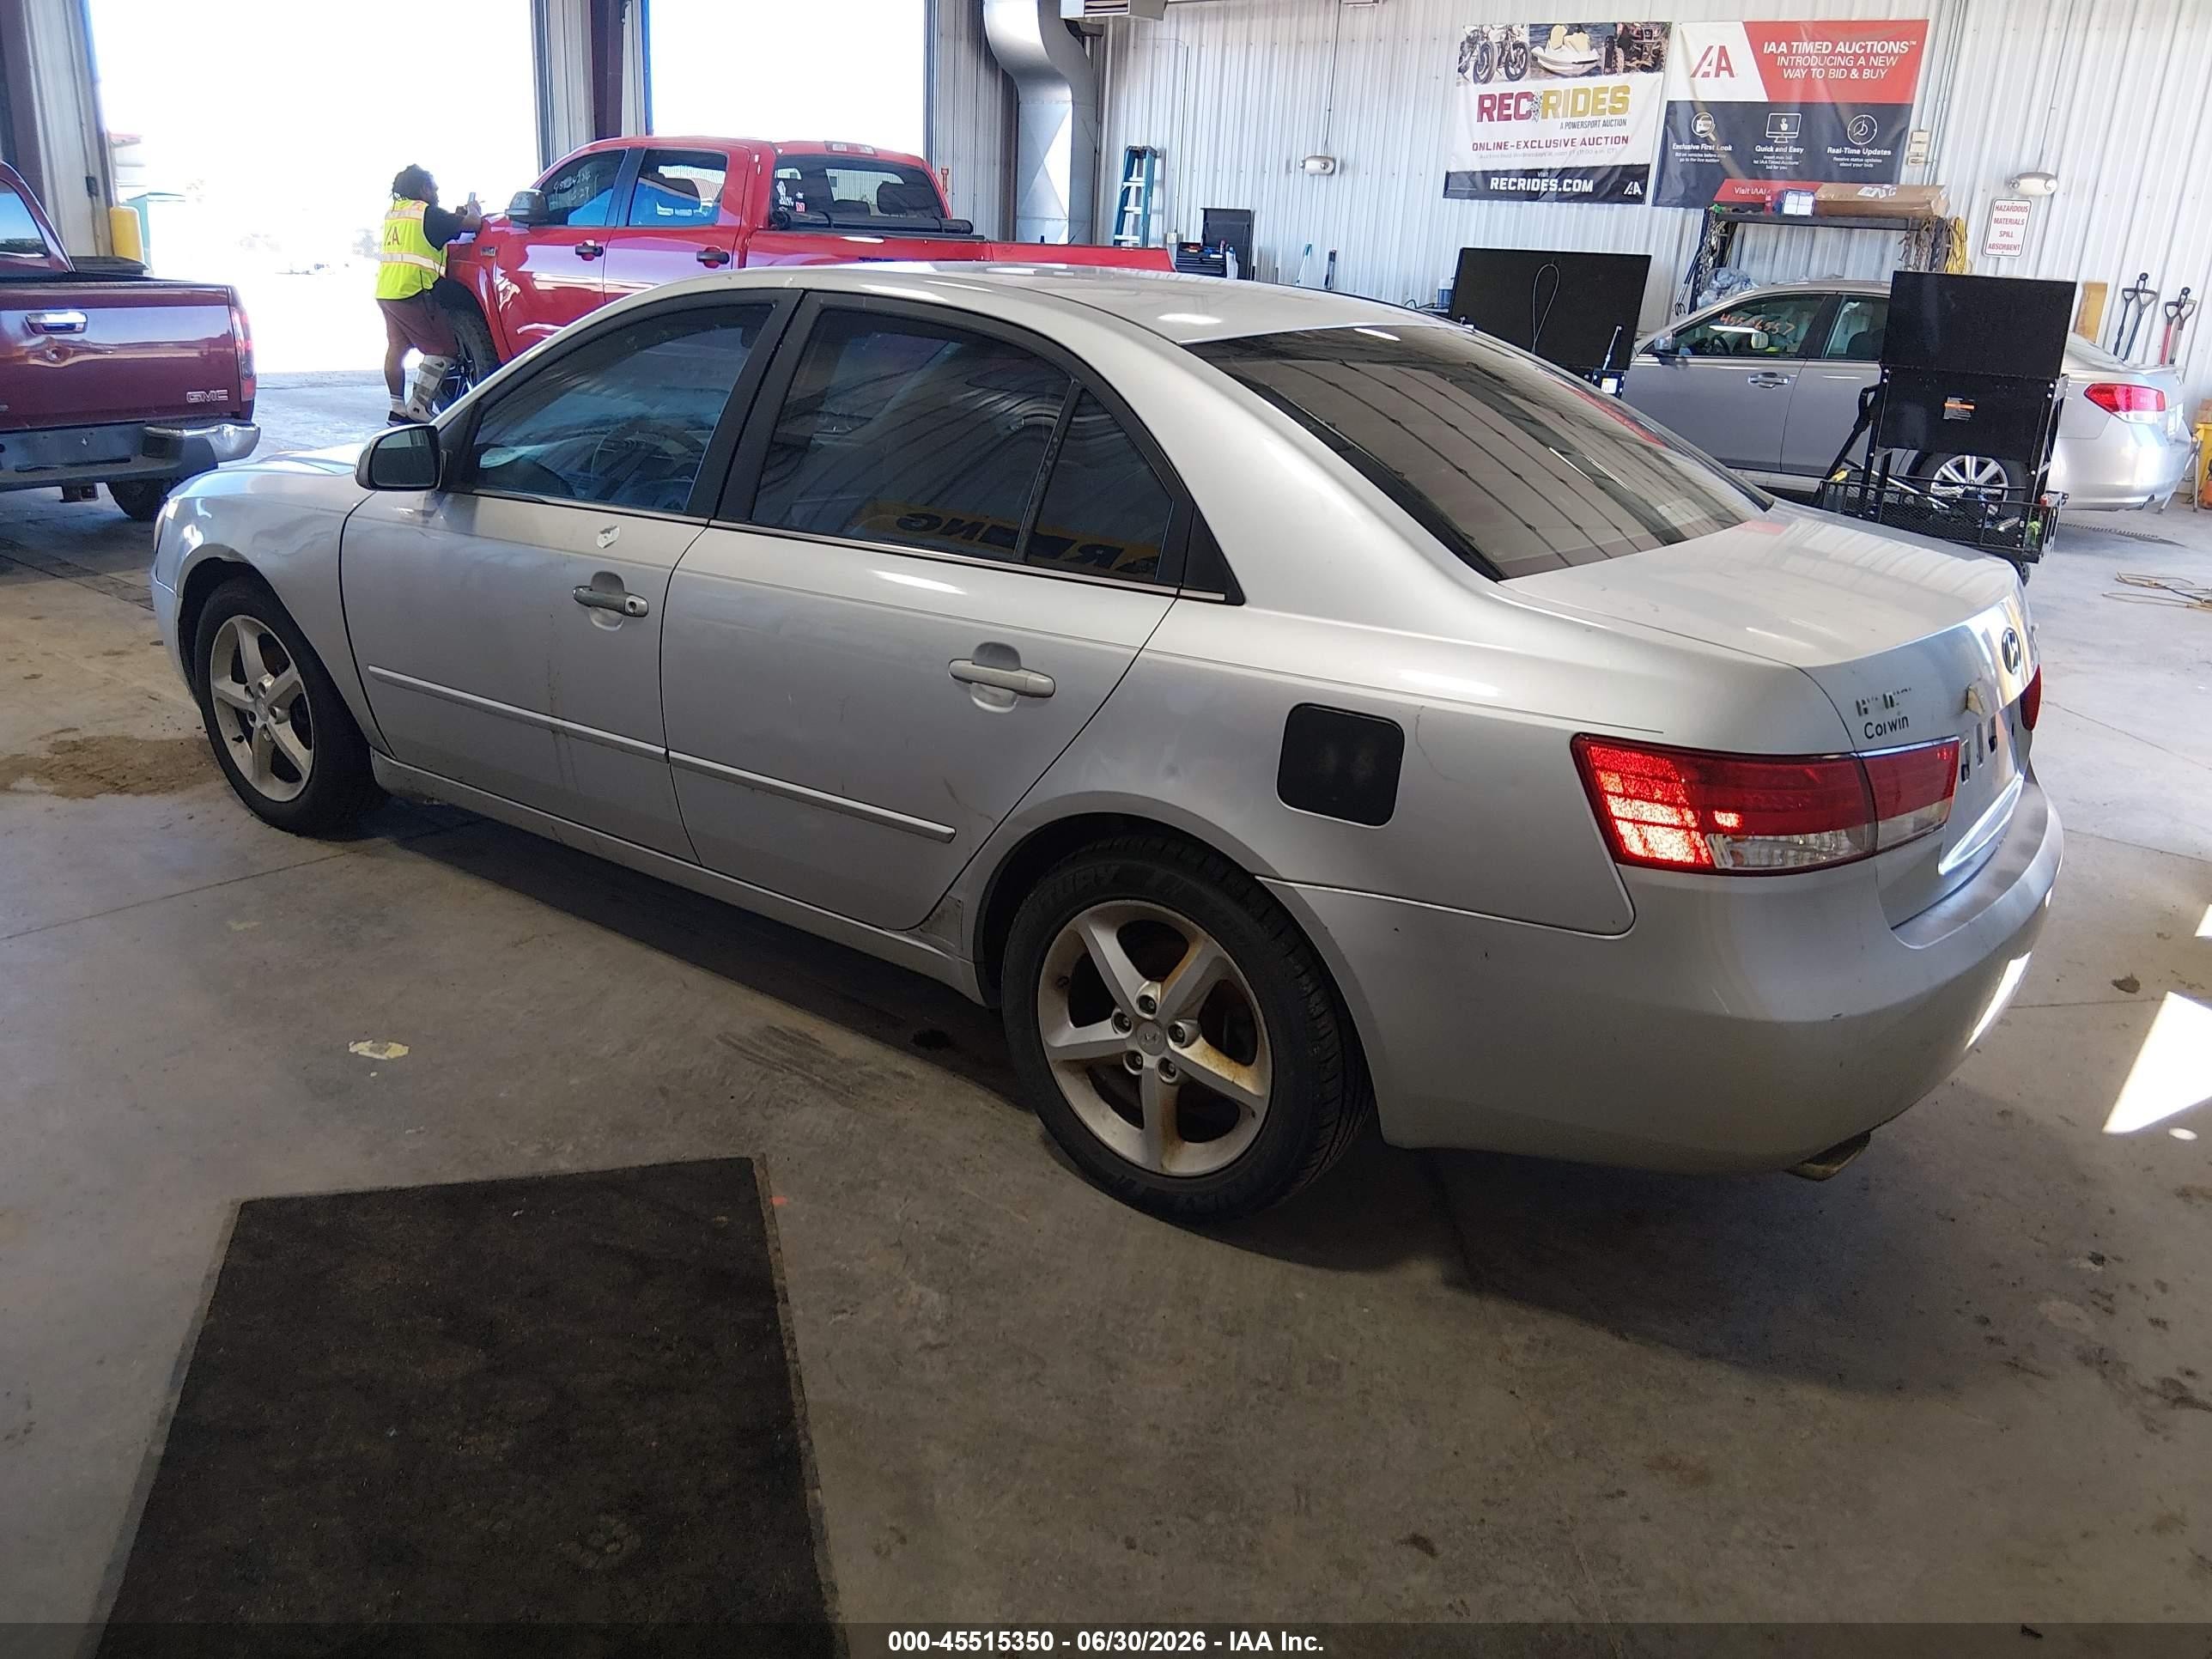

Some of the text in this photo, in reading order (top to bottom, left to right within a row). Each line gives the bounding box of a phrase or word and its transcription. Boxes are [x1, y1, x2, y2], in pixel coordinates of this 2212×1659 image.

[1763, 41, 1787, 54] IAA
[1791, 41, 1832, 54] TIMED
[1777, 56, 1899, 67] INTRODUCING A NEW
[1783, 68, 1888, 79] WAY TO BID & BUY
[1565, 120, 1601, 130] POWERSPORT
[1602, 118, 1627, 128] AUCTION
[1472, 136, 1629, 151] ONLINE-EXCLUSIVE AUCTION
[1701, 143, 1716, 151] First
[1788, 145, 1804, 155] Easy
[1826, 146, 1892, 156] Real-Time Updates
[1490, 177, 1594, 192] RECRIDES.COM
[1734, 186, 1750, 195] Visit
[1994, 204, 2029, 213] HAZARDOUS
[1993, 217, 2025, 226] MATERIALS
[186, 389, 228, 404] GMC
